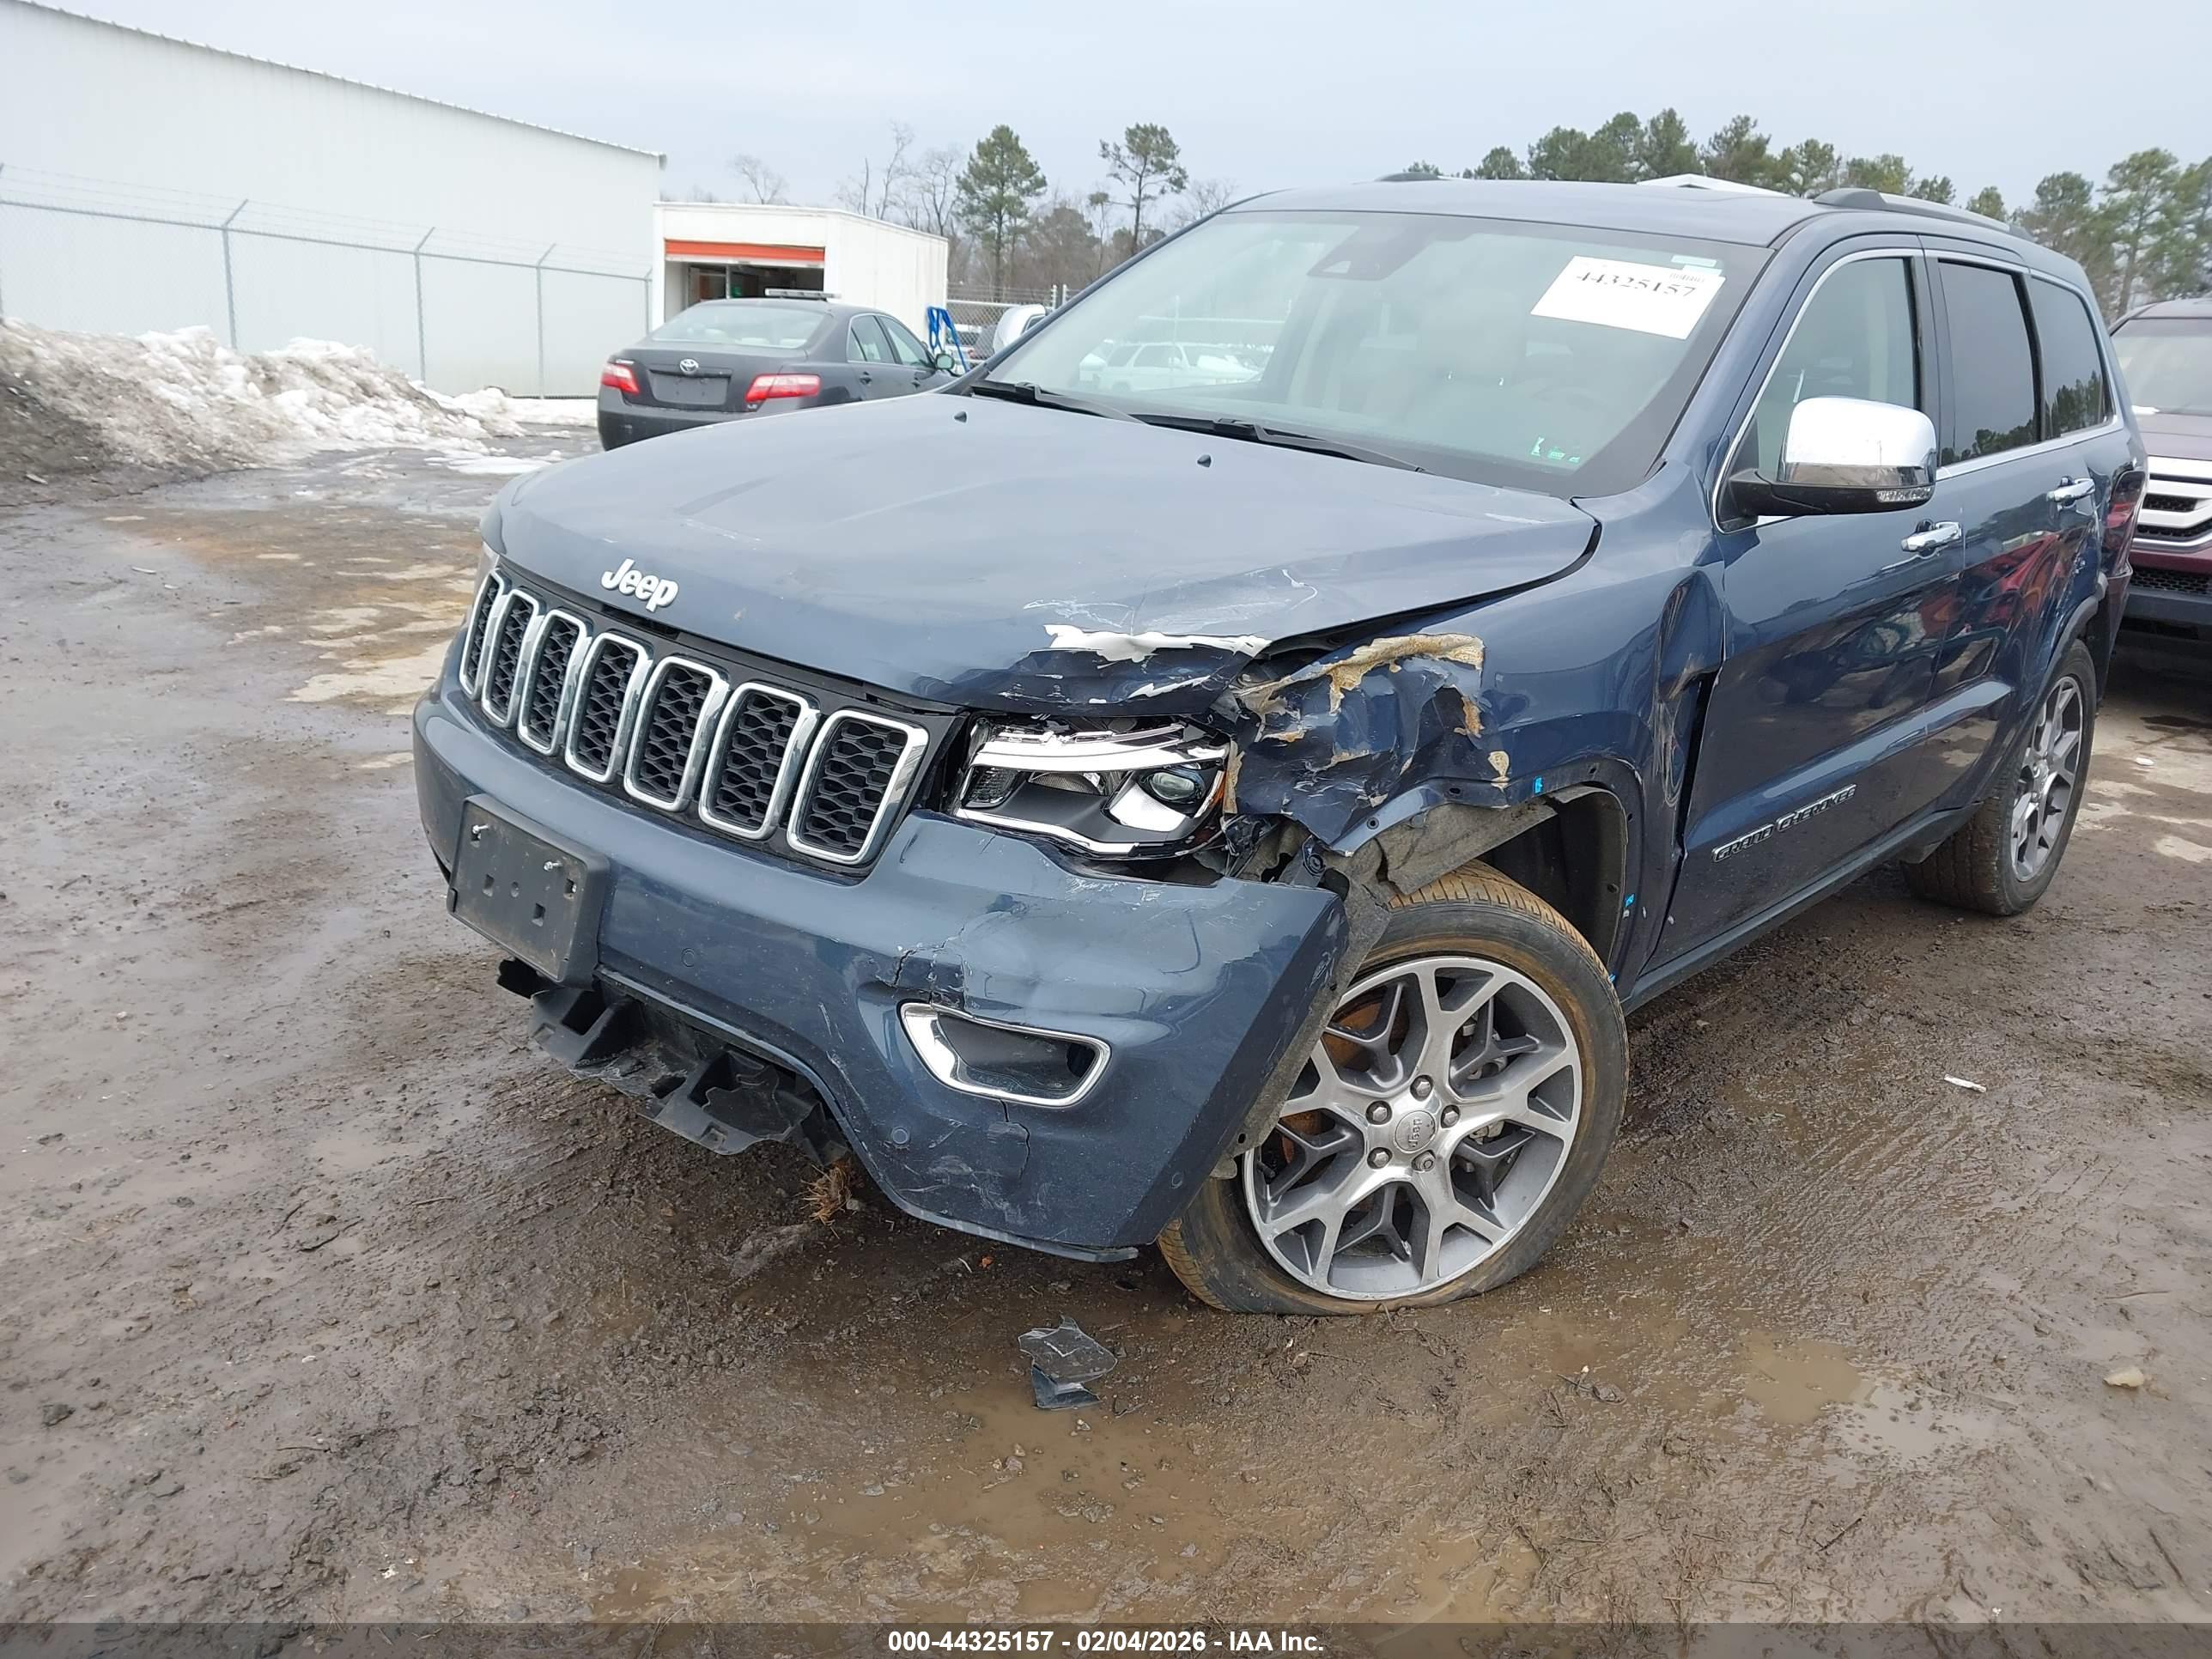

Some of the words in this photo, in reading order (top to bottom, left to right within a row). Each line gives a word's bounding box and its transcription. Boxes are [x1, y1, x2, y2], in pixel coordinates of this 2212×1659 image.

[1576, 271, 1697, 297] 44325157
[601, 558, 679, 612] Jeep
[1711, 823, 1774, 862] GRAND
[1776, 783, 1857, 832] CHEROKEE
[1408, 1116, 1423, 1148] Jeep
